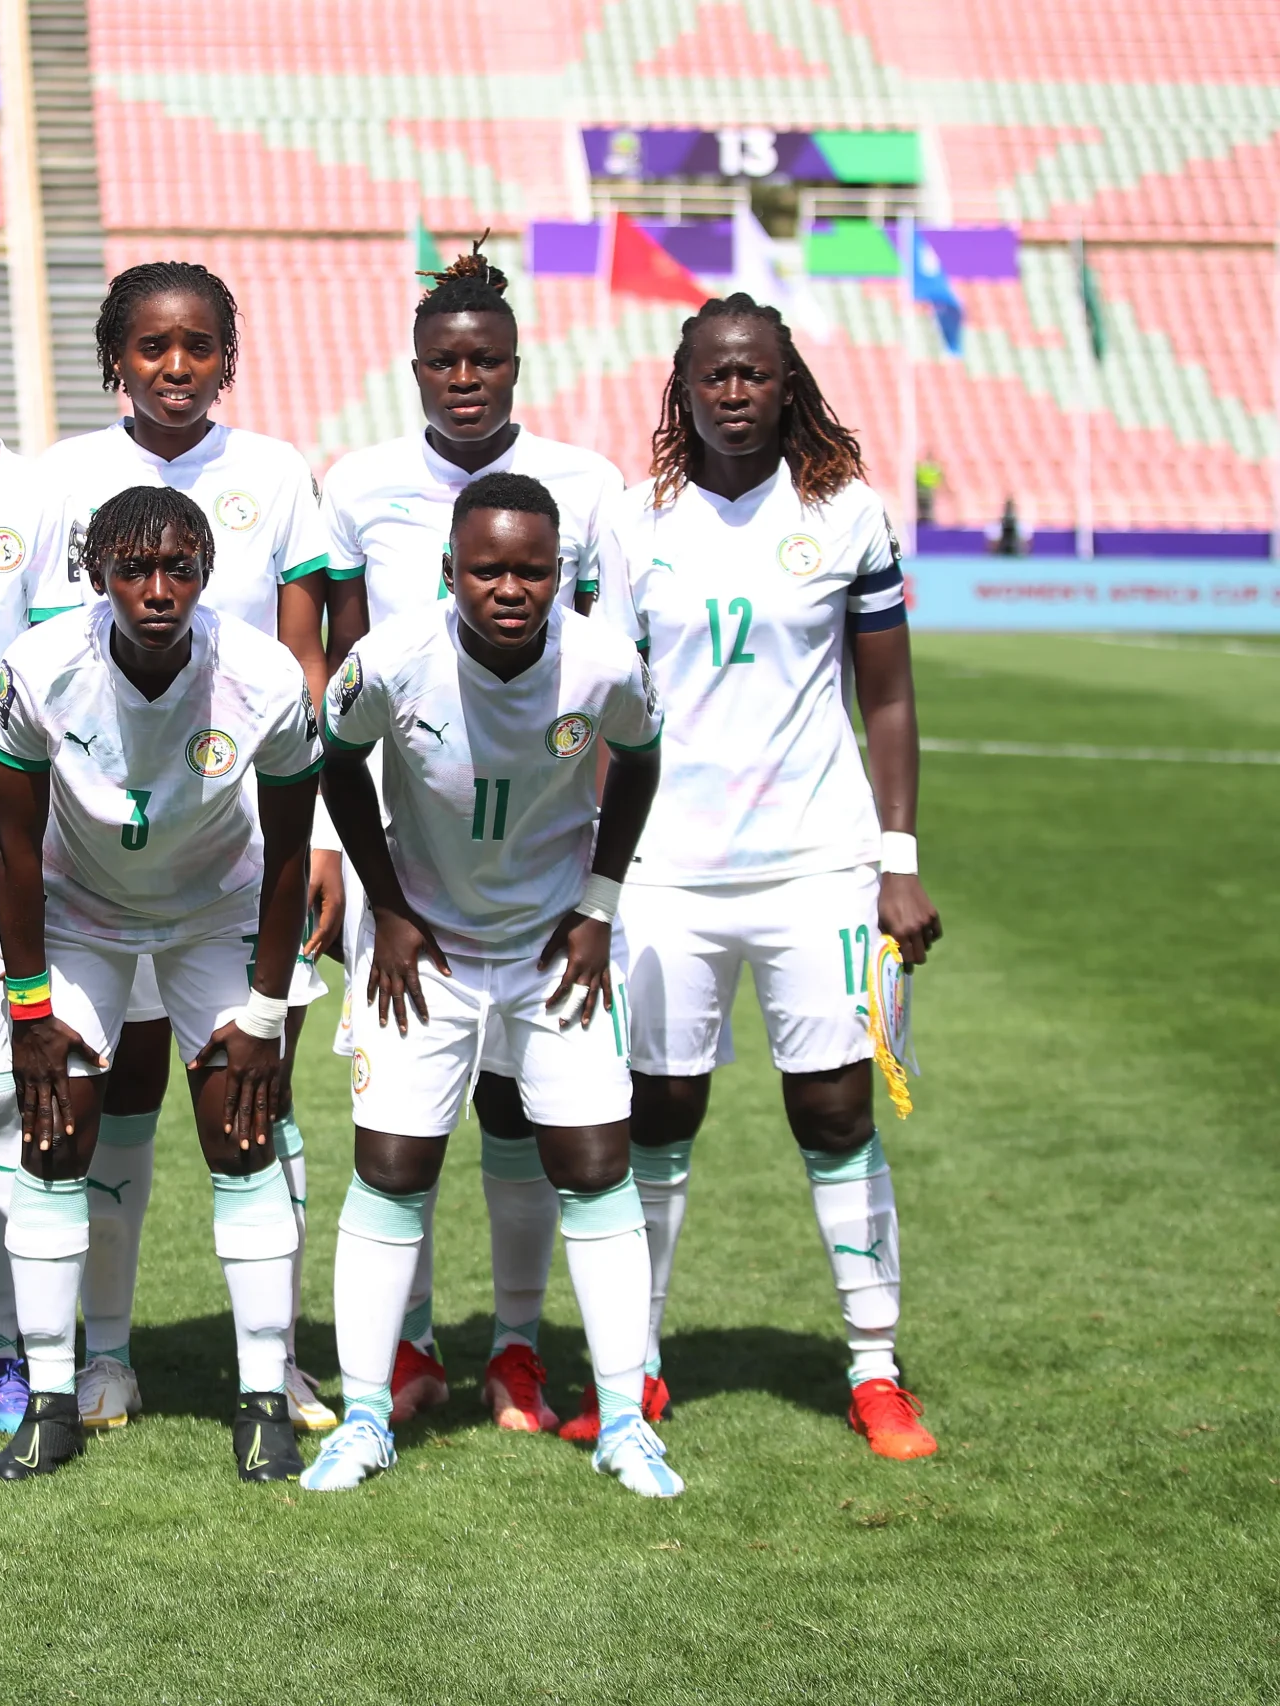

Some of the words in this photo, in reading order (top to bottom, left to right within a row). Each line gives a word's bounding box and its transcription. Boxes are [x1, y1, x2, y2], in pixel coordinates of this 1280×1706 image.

[715, 128, 779, 177] 13
[705, 597, 756, 668] 12
[121, 789, 152, 850] 3
[471, 778, 511, 841] 11
[838, 923, 870, 996] 12
